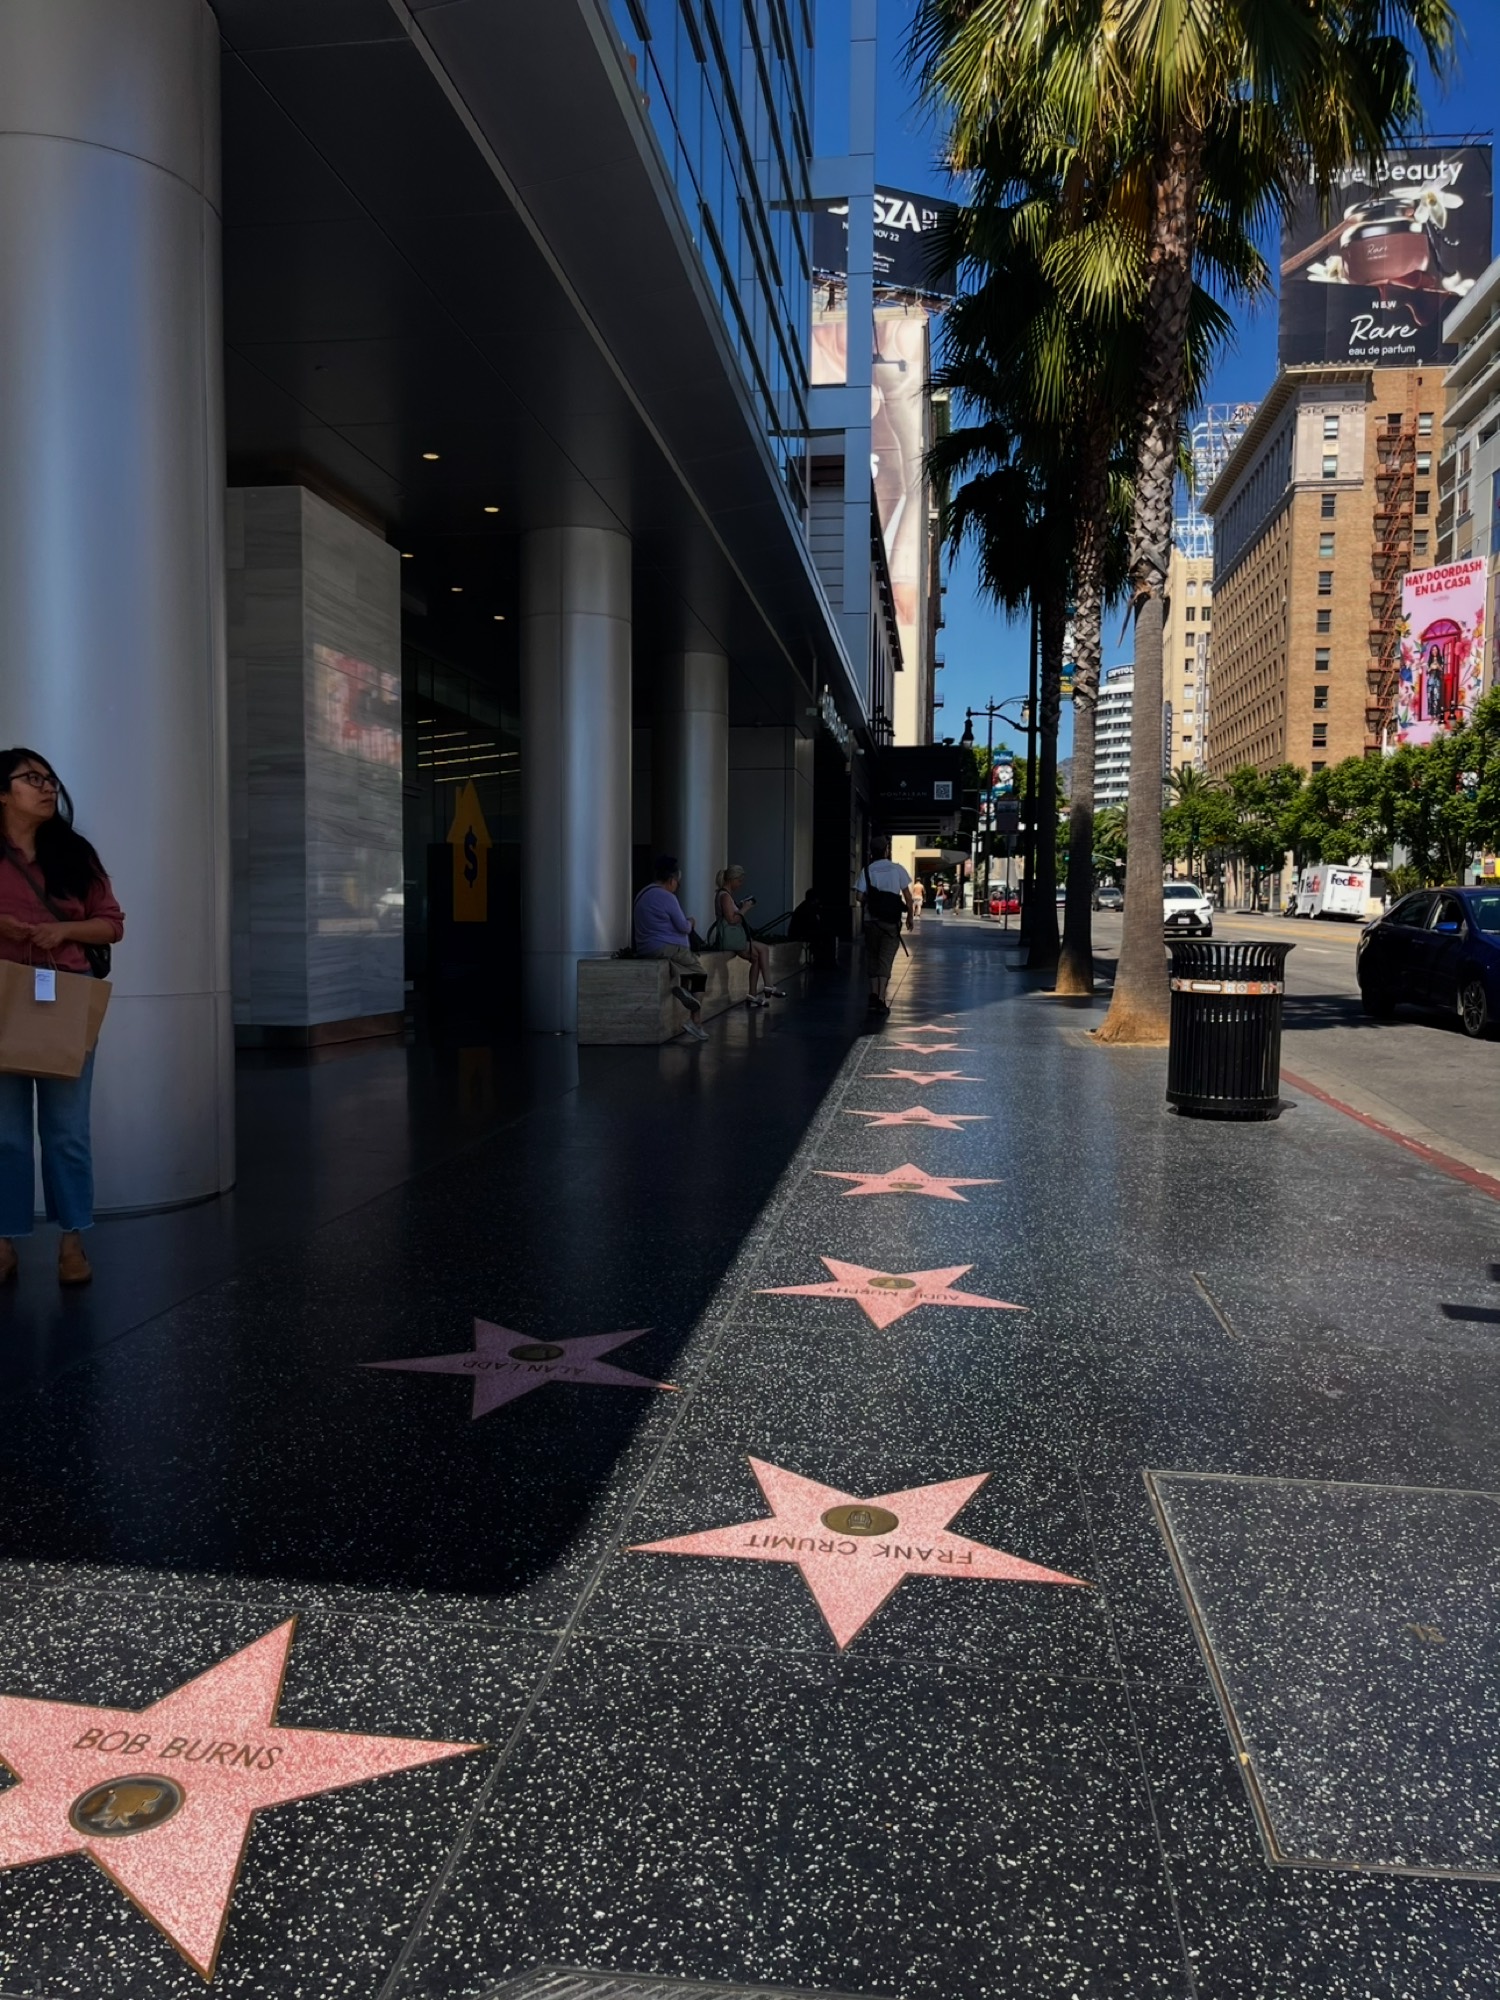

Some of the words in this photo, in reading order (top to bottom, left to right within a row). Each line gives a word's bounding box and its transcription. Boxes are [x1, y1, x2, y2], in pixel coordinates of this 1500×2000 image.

[873, 194, 921, 232] SZA
[890, 233, 900, 242] 22
[1371, 300, 1397, 310] NEW
[1349, 314, 1418, 345] Rare
[1348, 347, 1366, 356] eau
[1368, 345, 1380, 355] de
[1381, 343, 1416, 356] parfum
[1405, 573, 1424, 587] HAY
[1426, 560, 1482, 582] DOORDASH
[1415, 585, 1429, 596] EN
[1430, 580, 1443, 593] LA
[1444, 575, 1471, 590] CASA
[1331, 873, 1364, 888] FedEx
[822, 1286, 899, 1299] MURPHY
[462, 1360, 523, 1372] LADD
[527, 1363, 589, 1377] ALAN
[743, 1534, 858, 1556] CRUMIT
[872, 1543, 973, 1565] FRANK
[72, 1728, 151, 1754] BOB
[158, 1737, 284, 1770] BURNS
